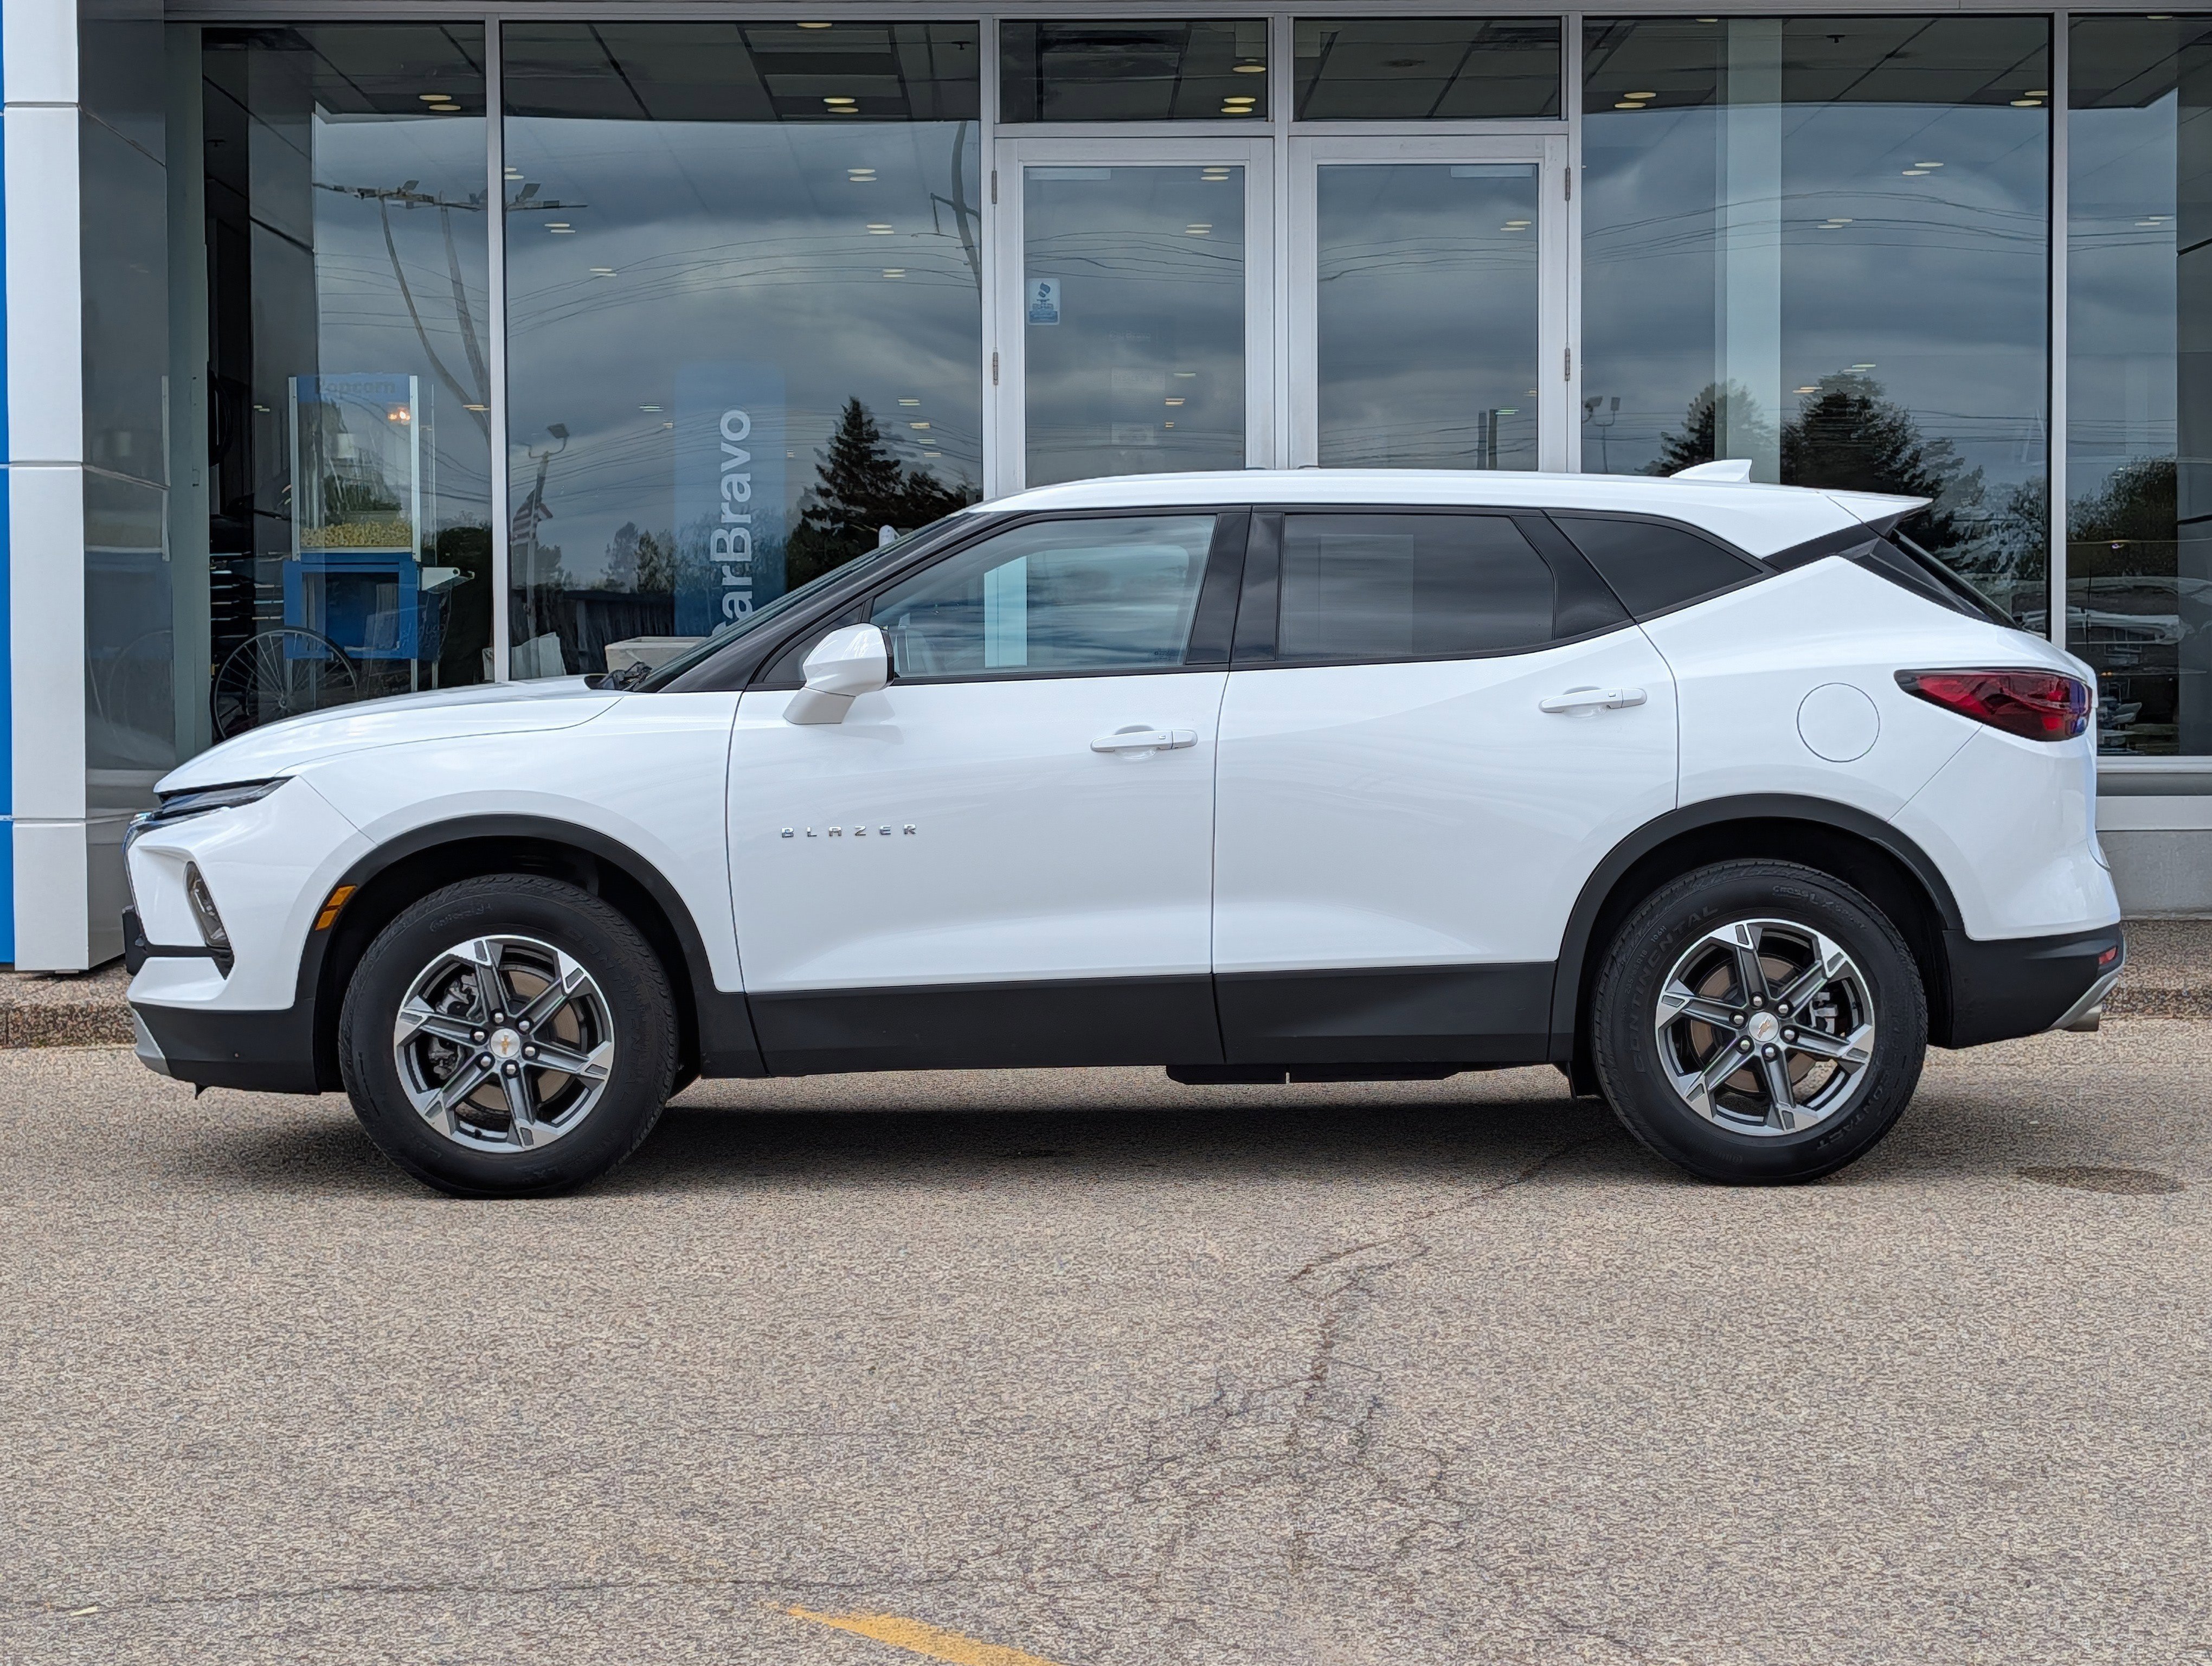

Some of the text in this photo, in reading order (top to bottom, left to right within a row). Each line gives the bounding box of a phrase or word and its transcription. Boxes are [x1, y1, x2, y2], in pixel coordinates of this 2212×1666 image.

[710, 409, 753, 638] arBravo
[781, 824, 916, 838] BLAZER
[1650, 925, 1667, 943] 106H
[1629, 904, 1719, 1074] CONTINENTAL
